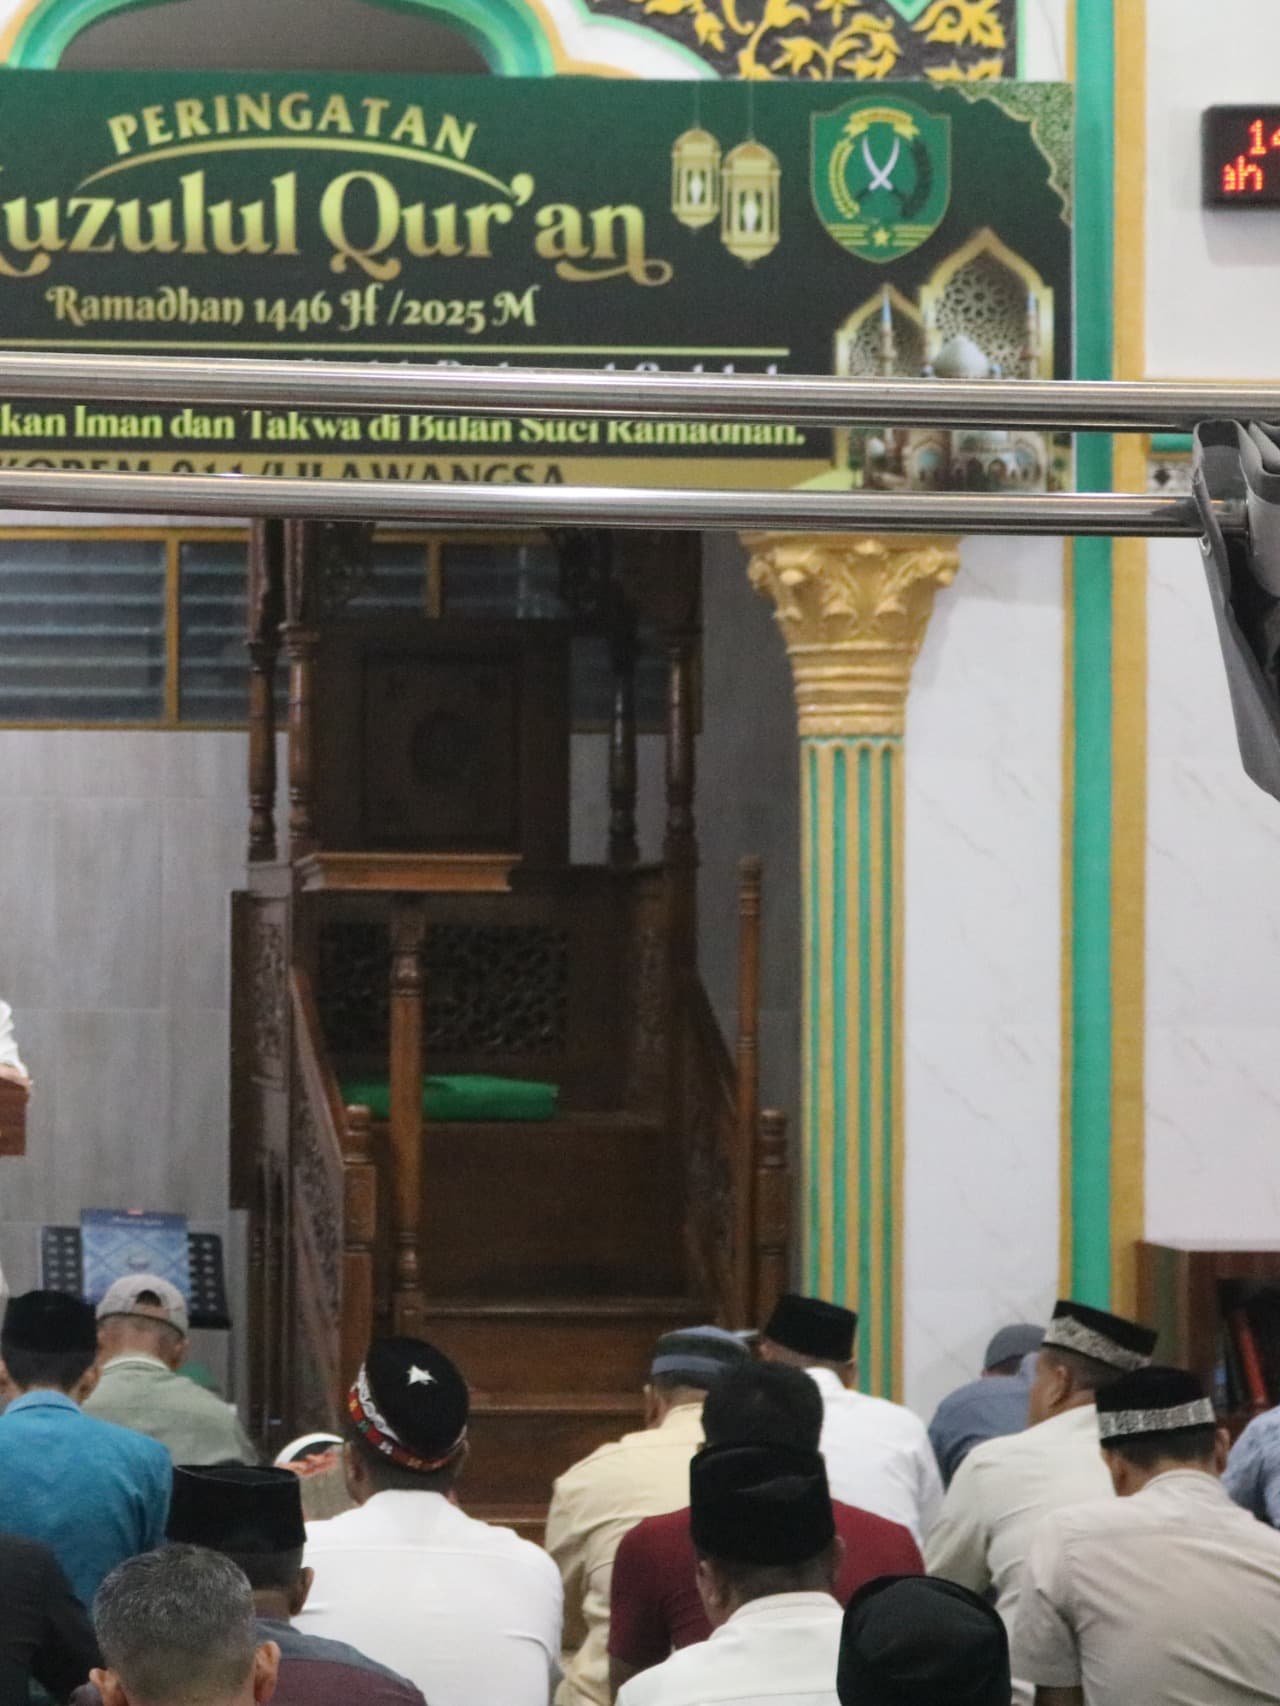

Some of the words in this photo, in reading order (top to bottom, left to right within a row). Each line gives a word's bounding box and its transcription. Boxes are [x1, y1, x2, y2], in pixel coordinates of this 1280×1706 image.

[107, 92, 477, 160] PERINGATAN
[320, 170, 674, 287] Qur'an
[45, 285, 245, 326] Ramadhan
[254, 290, 333, 332] 1446
[491, 284, 540, 328] M
[74, 405, 163, 438] Iman
[170, 408, 235, 439] dan
[241, 410, 361, 440] Takwa
[368, 413, 401, 441] di
[409, 415, 513, 442] Bulan
[519, 417, 599, 443] Suci
